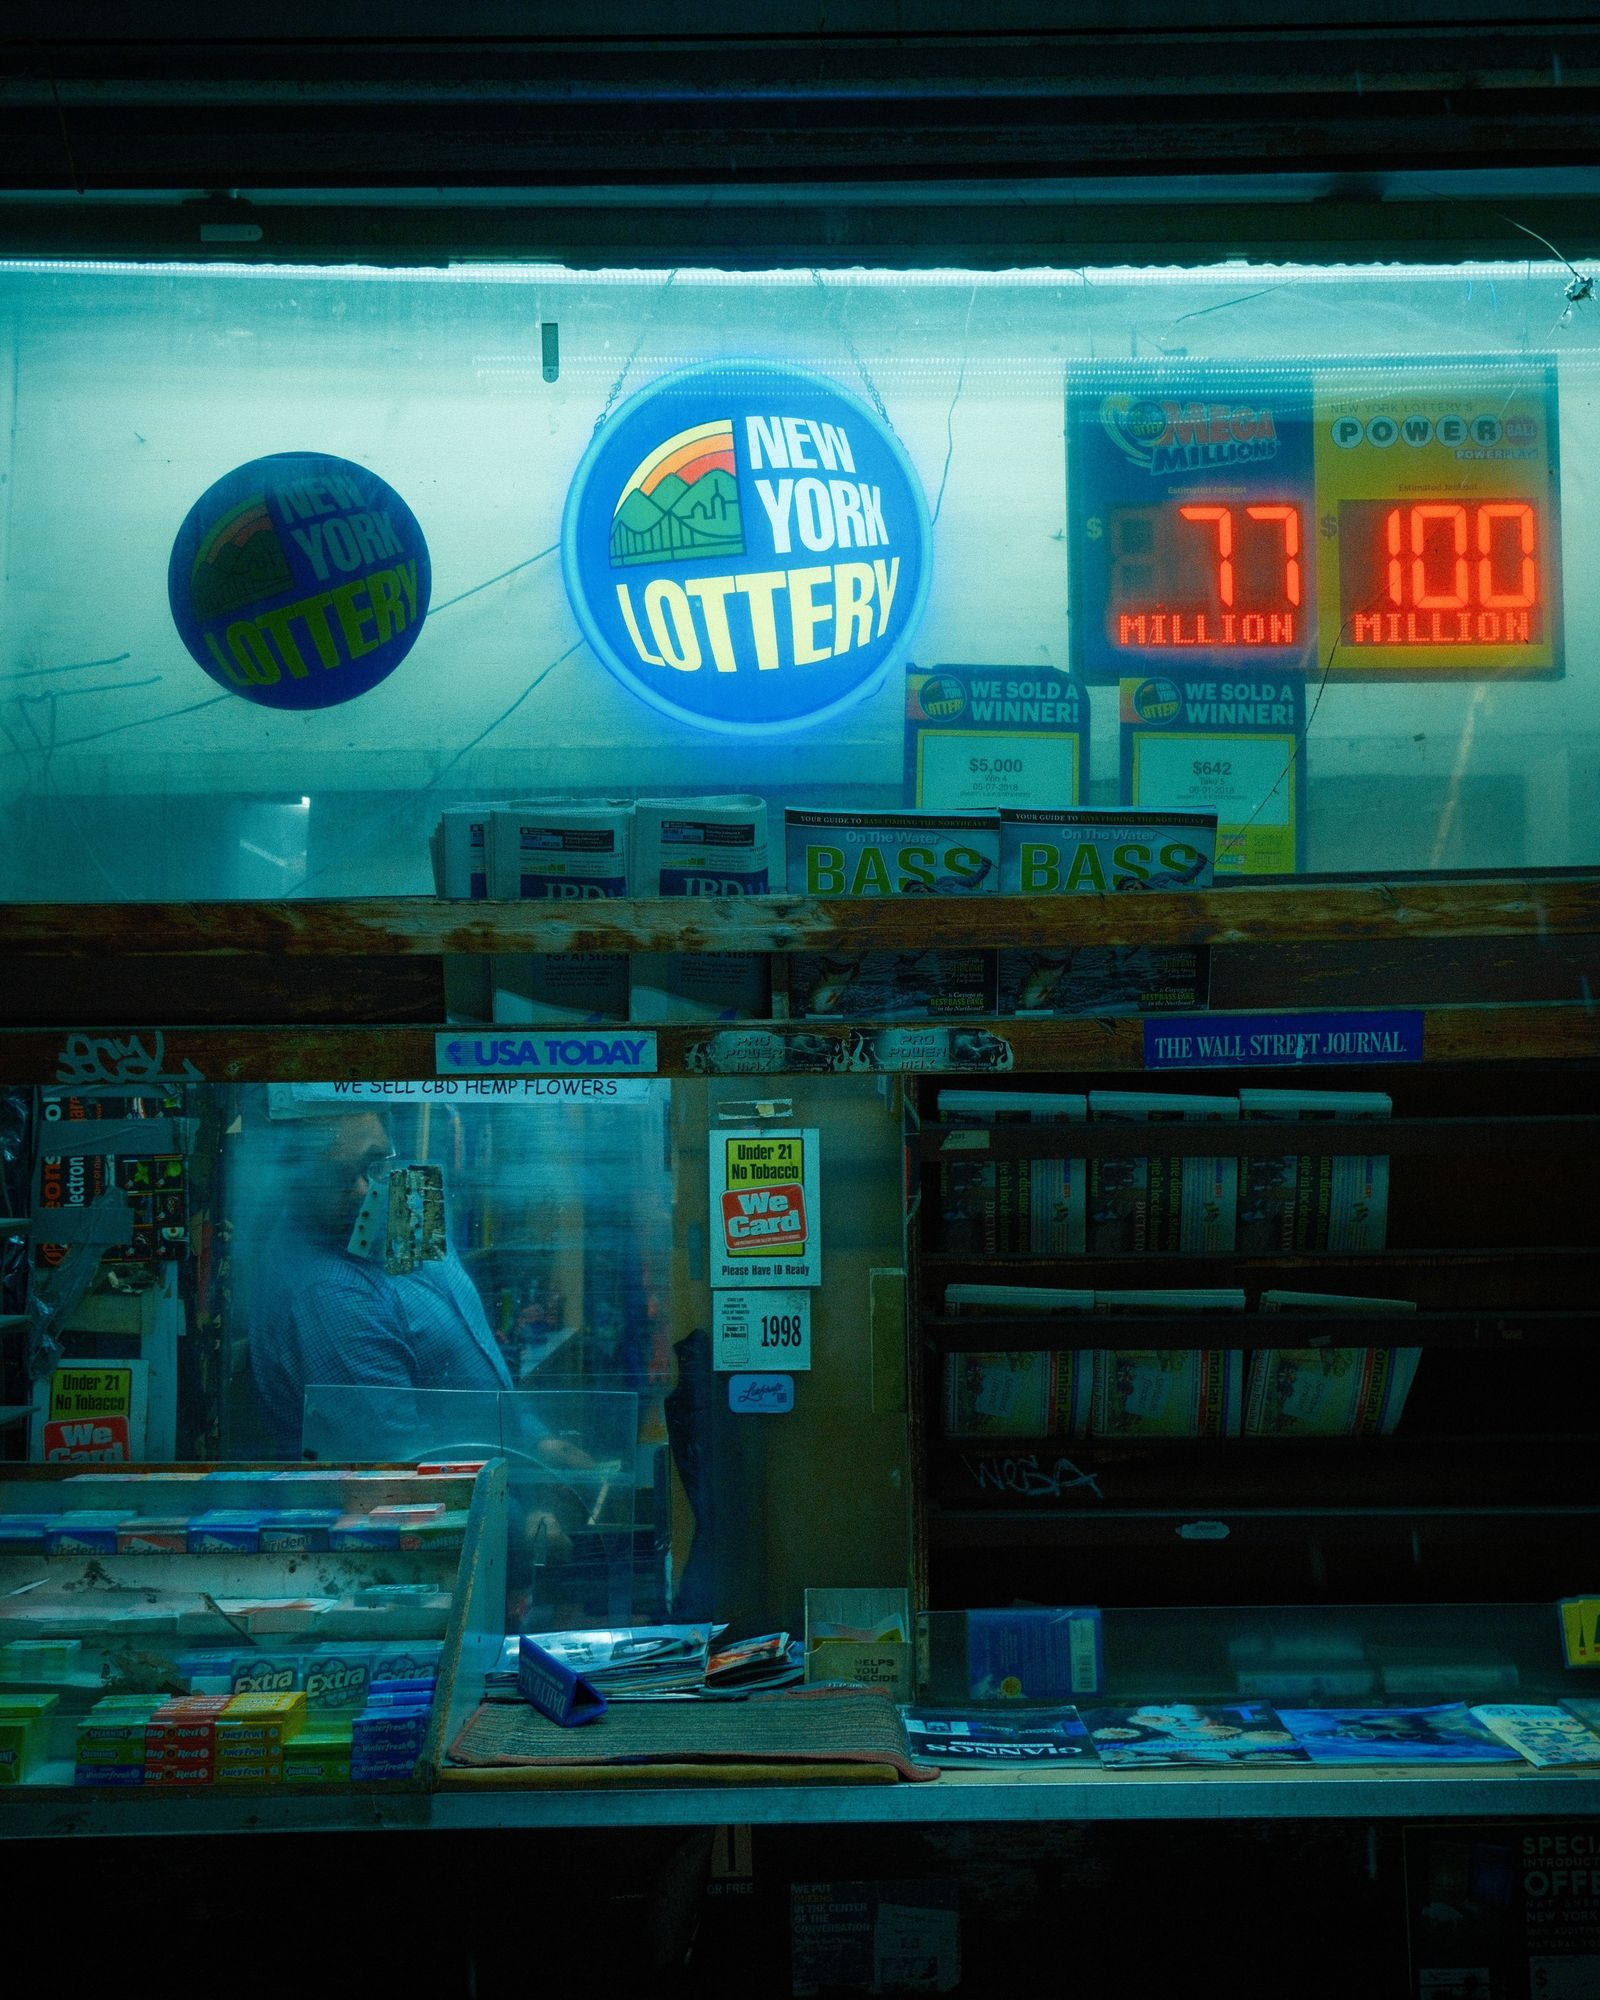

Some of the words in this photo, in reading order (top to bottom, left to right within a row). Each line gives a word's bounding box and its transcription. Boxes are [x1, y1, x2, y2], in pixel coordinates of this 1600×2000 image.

[1157, 400, 1278, 448] MEGA
[1335, 417, 1500, 446] POWER
[746, 415, 857, 474] NEW
[1151, 437, 1278, 477] MILLIONS
[274, 474, 366, 525] NEW
[754, 477, 890, 554] YORK
[289, 510, 405, 582] YORK
[1086, 517, 1103, 540] $
[1180, 506, 1299, 608] 77
[1320, 514, 1339, 538] $
[1388, 504, 1536, 609] 100
[203, 557, 418, 688] LOTTERY
[615, 557, 901, 673] LOTTERY
[1119, 614, 1294, 644] MILLION
[1355, 611, 1529, 643] MILLION
[970, 681, 1002, 699] WE
[1006, 681, 1061, 700] SOLD
[1065, 684, 1080, 700] A
[1185, 683, 1217, 700] WE
[1222, 683, 1277, 701] SOLD
[1280, 685, 1295, 702] A
[971, 701, 1080, 724] WINNER!
[1186, 702, 1295, 725] WINNER!
[969, 758, 1024, 774] $5,000
[1192, 761, 1233, 776] $642
[800, 815, 822, 823] YOUR
[823, 816, 849, 824] GUIDE
[851, 817, 863, 825] TO
[1015, 813, 1038, 821] YOUR
[1039, 814, 1065, 822] GUIDE
[1067, 814, 1079, 822] TO
[845, 831, 866, 844] On
[869, 831, 895, 843] The
[896, 832, 940, 845] Water
[1061, 827, 1083, 841] On
[1085, 827, 1109, 840] The
[1110, 828, 1158, 841] Water
[806, 845, 982, 895] BASS
[1019, 842, 1197, 891] BASS
[474, 1039, 539, 1066] USA
[544, 1039, 648, 1065] TODAY
[725, 1047, 784, 1060] POWER
[888, 1046, 948, 1059] POWER
[1154, 1037, 1193, 1059] THE
[1196, 1035, 1245, 1058] WALL
[1250, 1033, 1320, 1057] STREET
[333, 1080, 362, 1093] WE
[370, 1080, 415, 1094] SELL
[422, 1080, 458, 1095] CBD
[465, 1080, 518, 1096] HEMP
[524, 1080, 618, 1096] FLOWERS
[737, 1144, 774, 1160] Under
[778, 1143, 792, 1160] 21
[731, 1163, 748, 1179] No
[750, 1162, 799, 1180] Tobacco
[737, 1191, 789, 1215] We
[727, 1209, 802, 1239] Card
[722, 1265, 749, 1276] Please
[751, 1265, 771, 1276] Have
[773, 1264, 783, 1275] ID
[785, 1264, 810, 1276] Ready
[761, 1314, 802, 1348] 1998
[63, 1374, 101, 1391] Under
[104, 1374, 120, 1391] 21
[55, 1394, 72, 1410] No
[75, 1394, 126, 1411] Tobacco
[60, 1423, 113, 1447] We
[263, 1534, 313, 1552] Trident
[854, 1658, 895, 1667] HELPS
[855, 1667, 879, 1675] YOU
[234, 1669, 294, 1695] Extra
[307, 1667, 365, 1698] Extra
[147, 1728, 164, 1738] Big
[177, 1728, 200, 1737] Red
[362, 1721, 407, 1732] Winterfresh
[146, 1749, 164, 1759] Big
[176, 1749, 199, 1758] Red
[362, 1741, 407, 1752] Winterfresh
[145, 1770, 163, 1780] Big
[175, 1770, 198, 1779] Red
[360, 1762, 406, 1773] Winterfresh
[1522, 1835, 1600, 1855] SPECI
[706, 1883, 723, 1895] OR
[726, 1882, 754, 1894] FREE
[811, 1883, 831, 1894] PUT
[1526, 1911, 1556, 1922] NEW
[1562, 1910, 1598, 1922] YORK
